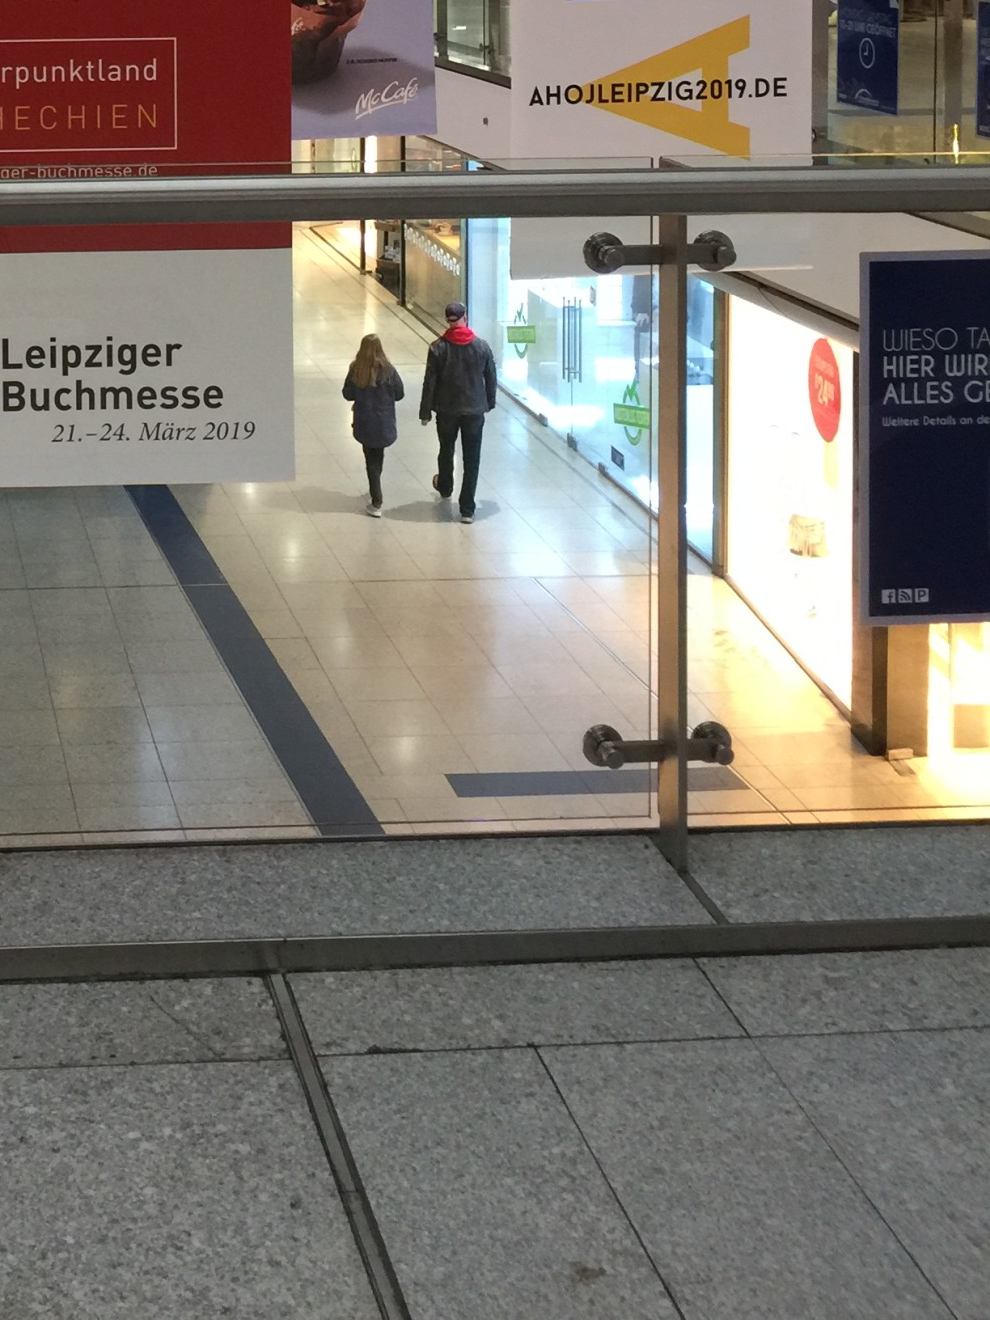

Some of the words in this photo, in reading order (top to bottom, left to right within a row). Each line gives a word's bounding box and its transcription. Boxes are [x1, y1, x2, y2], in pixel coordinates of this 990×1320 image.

[528, 76, 788, 109] AHOJLEIPZIG2019.DE
[882, 327, 959, 352] WIESO
[1, 336, 182, 376] Leipziger
[883, 354, 935, 378] HIER
[944, 353, 989, 377] WIR
[1, 379, 224, 412] Buchmesse
[882, 380, 955, 405] ALLES
[138, 421, 197, 442] März
[202, 421, 257, 442] 2019
[882, 416, 920, 427] Weitere
[923, 415, 956, 426] Details
[959, 417, 973, 425] an
